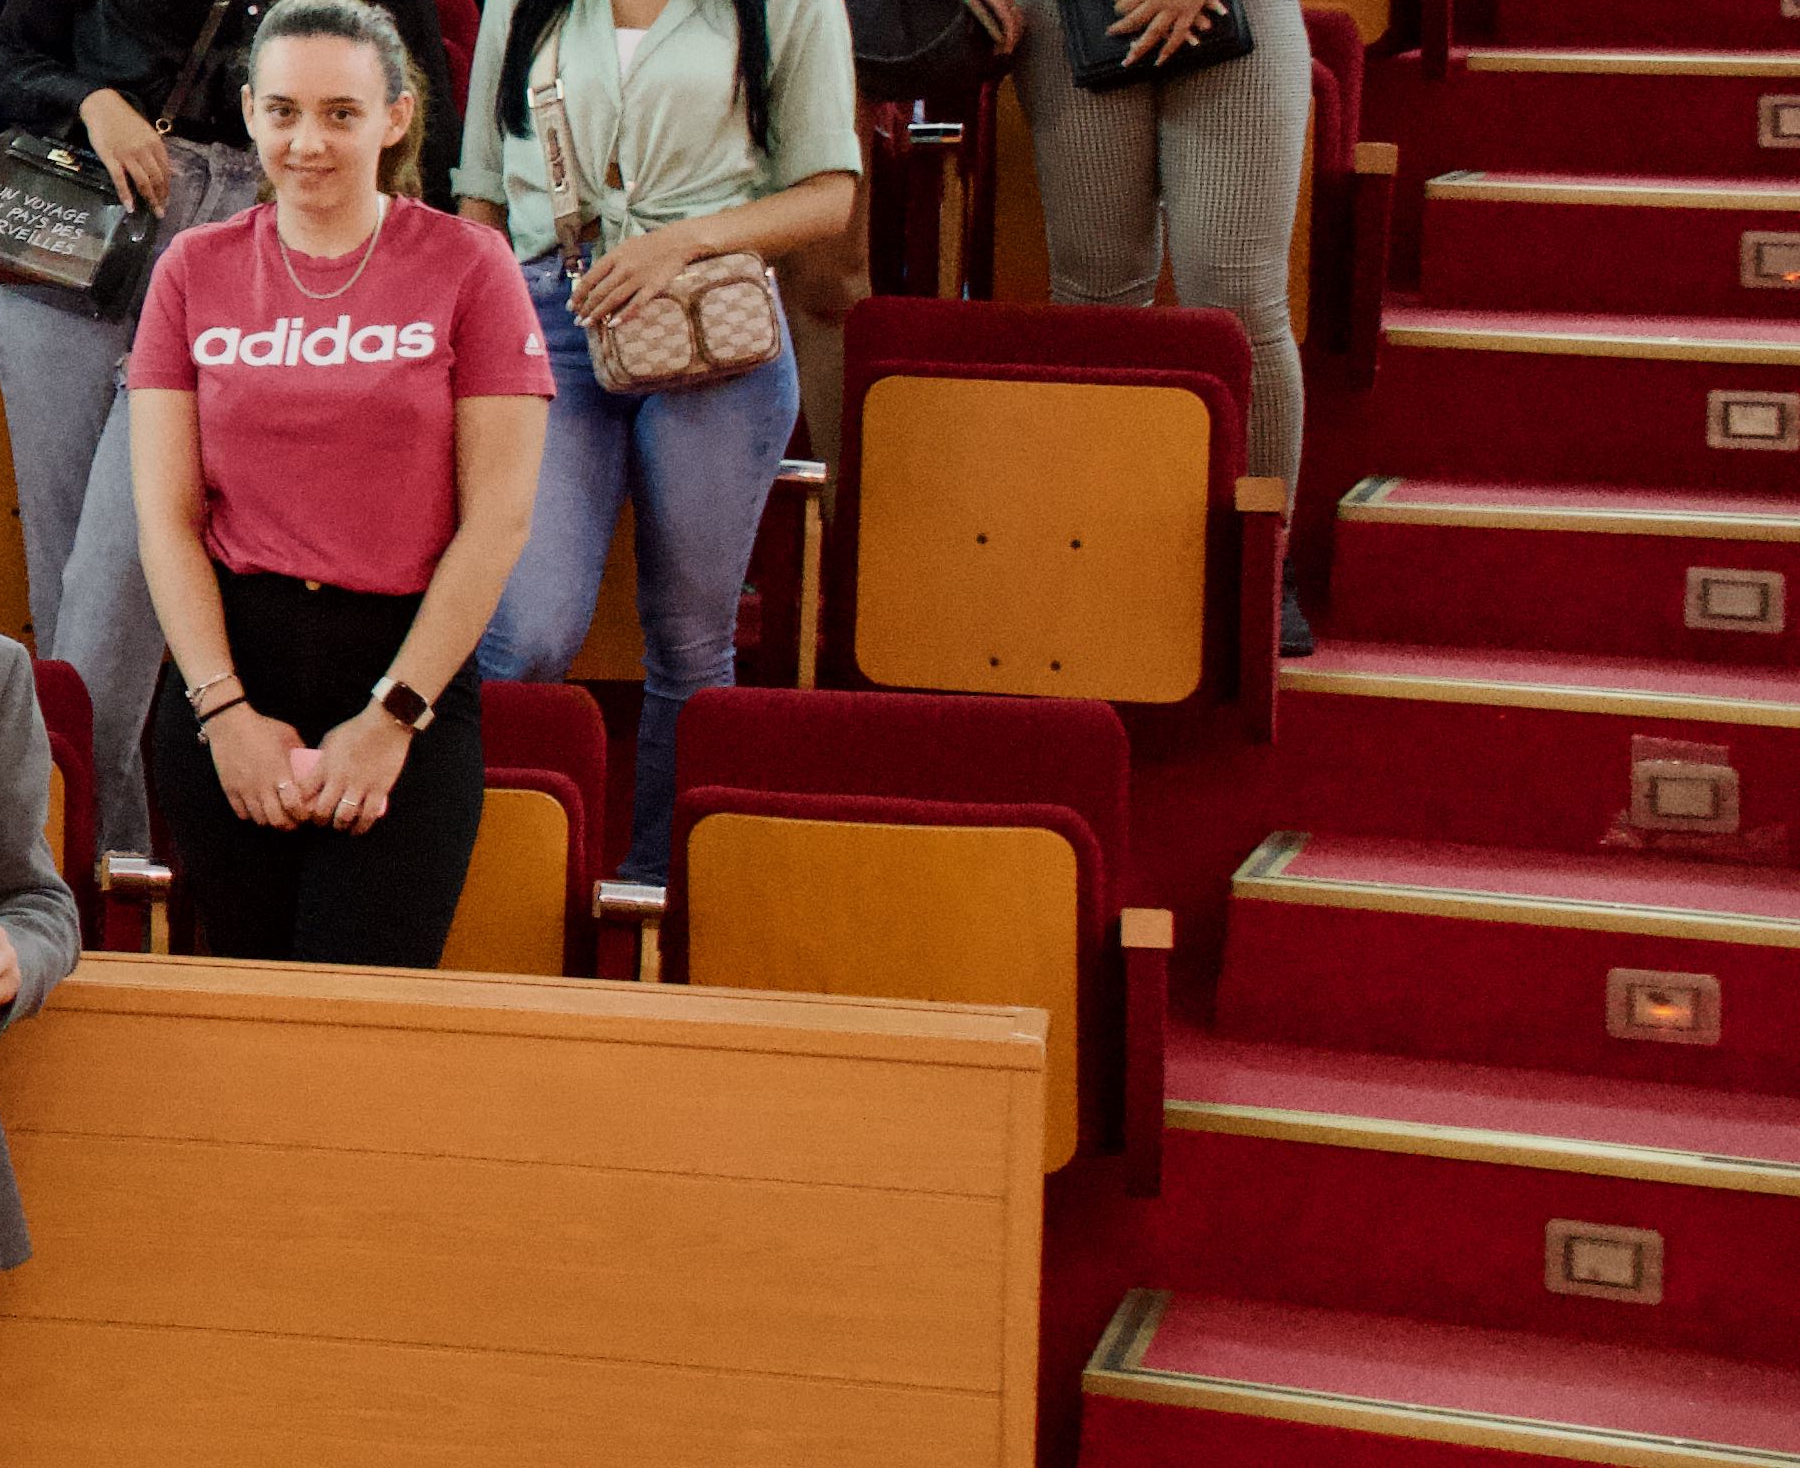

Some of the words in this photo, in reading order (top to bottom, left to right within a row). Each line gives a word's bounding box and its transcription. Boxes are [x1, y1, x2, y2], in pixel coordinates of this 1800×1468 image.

[5, 206, 51, 230] PAYS
[51, 221, 85, 241] DES
[23, 193, 91, 225] VOYAGE
[193, 313, 436, 367] adidas
